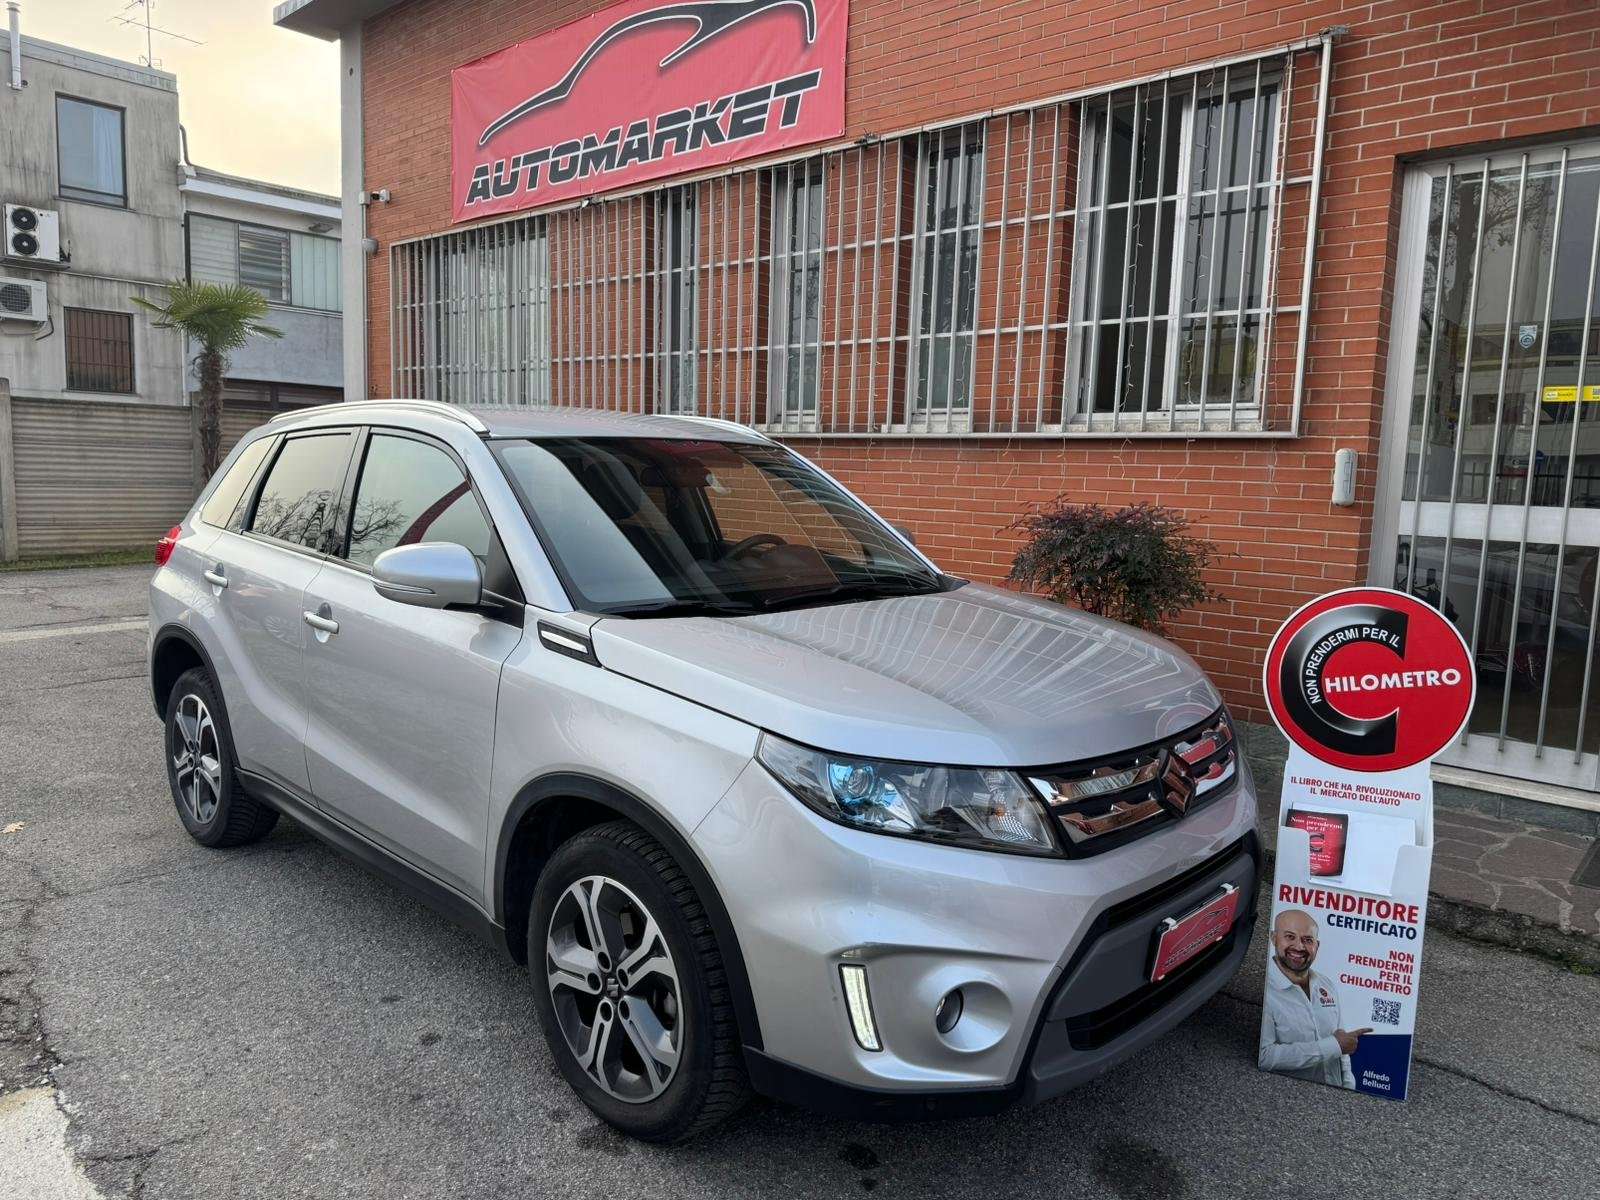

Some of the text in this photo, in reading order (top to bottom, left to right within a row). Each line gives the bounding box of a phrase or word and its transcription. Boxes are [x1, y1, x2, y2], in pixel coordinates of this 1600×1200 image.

[464, 68, 822, 208] AUTOMARKET
[1306, 627, 1401, 704] NON PRENDERMI PER IL
[1290, 776, 1421, 801] IL LIBRO CHE HA RIVOLUZIONATO
[1310, 788, 1401, 806] IL MERCATO DELL'AUTO
[1278, 884, 1420, 924] RIVENDITORE
[1326, 914, 1417, 940] CERTIFICATO
[1348, 954, 1414, 974] PRENDERMI
[1389, 950, 1415, 963] NON
[1339, 974, 1412, 996] CHILOMETRO
[1379, 971, 1413, 985] PER IL
[1362, 1078, 1391, 1091] Bellucci
[1363, 1069, 1391, 1082] Alfredo
